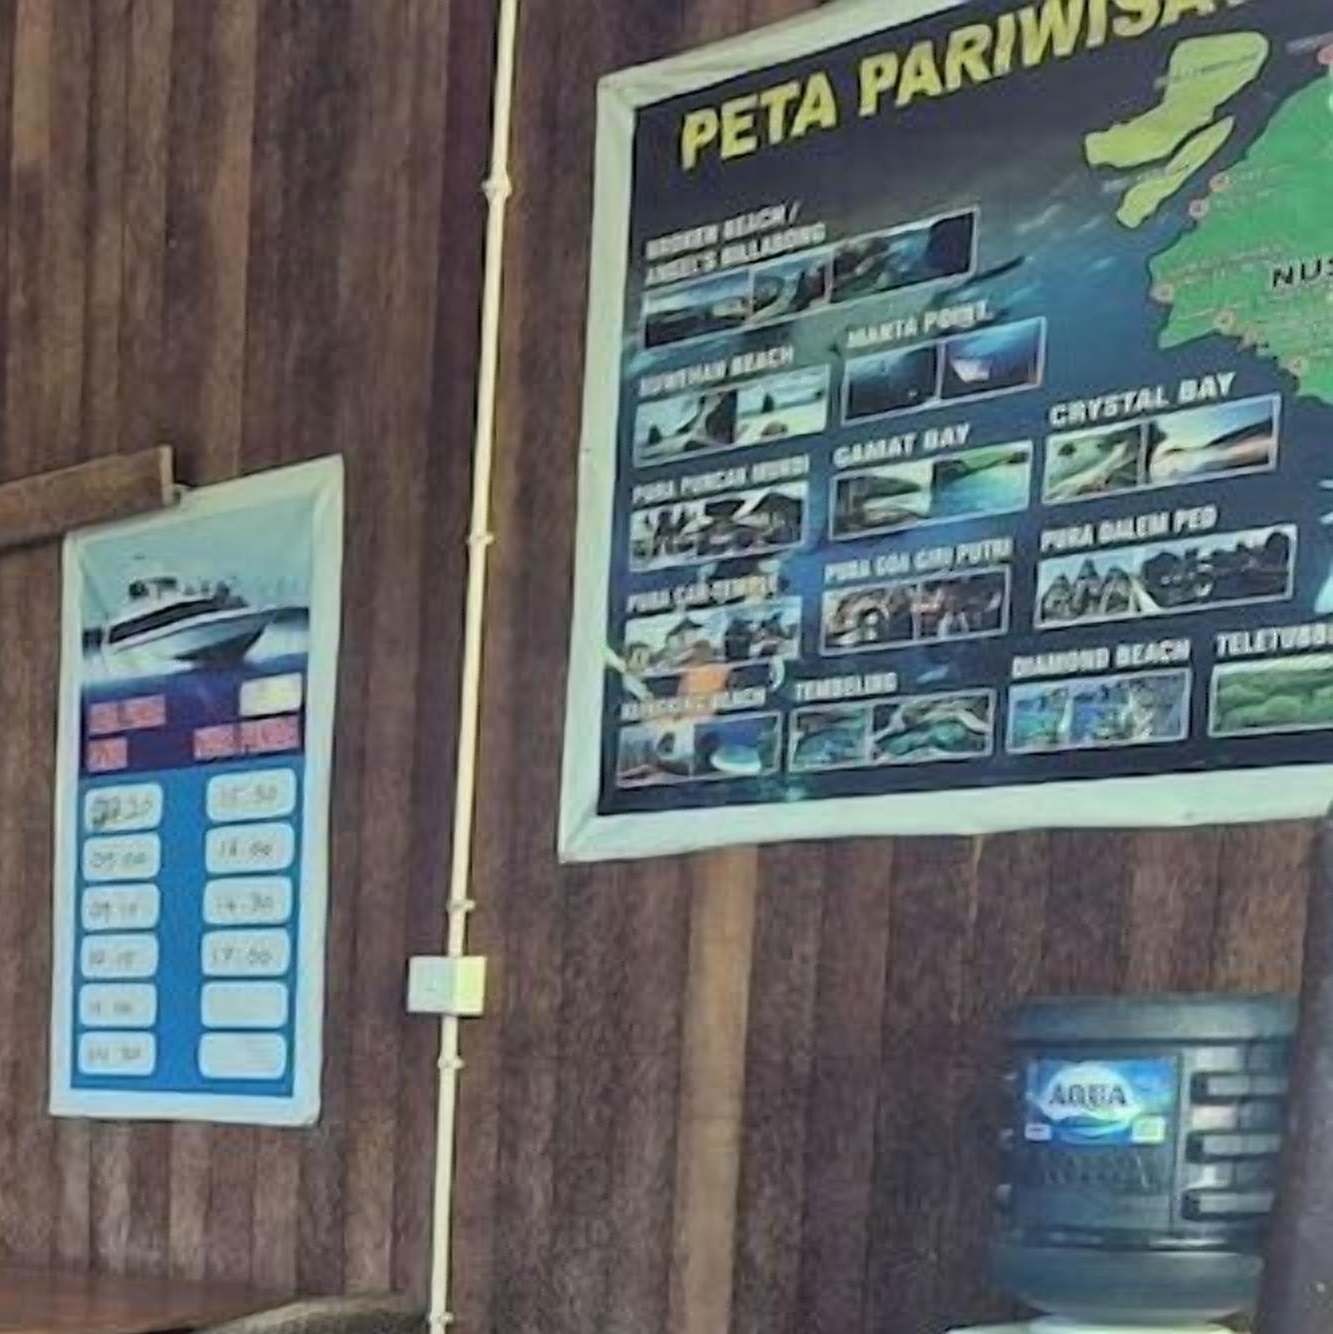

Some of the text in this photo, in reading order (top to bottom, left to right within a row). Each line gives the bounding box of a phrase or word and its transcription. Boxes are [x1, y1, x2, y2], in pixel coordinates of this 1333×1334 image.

[682, 0, 1245, 170] PETA PARIWIS
[731, 345, 795, 382] BEACH
[1049, 371, 1236, 427] CRYSTAL BAY
[833, 423, 971, 468] GAMAT BAY
[1040, 524, 1093, 552] PURA
[1012, 638, 1191, 679] DIAMOND BEACH
[1049, 1083, 1127, 1110] AQUA
